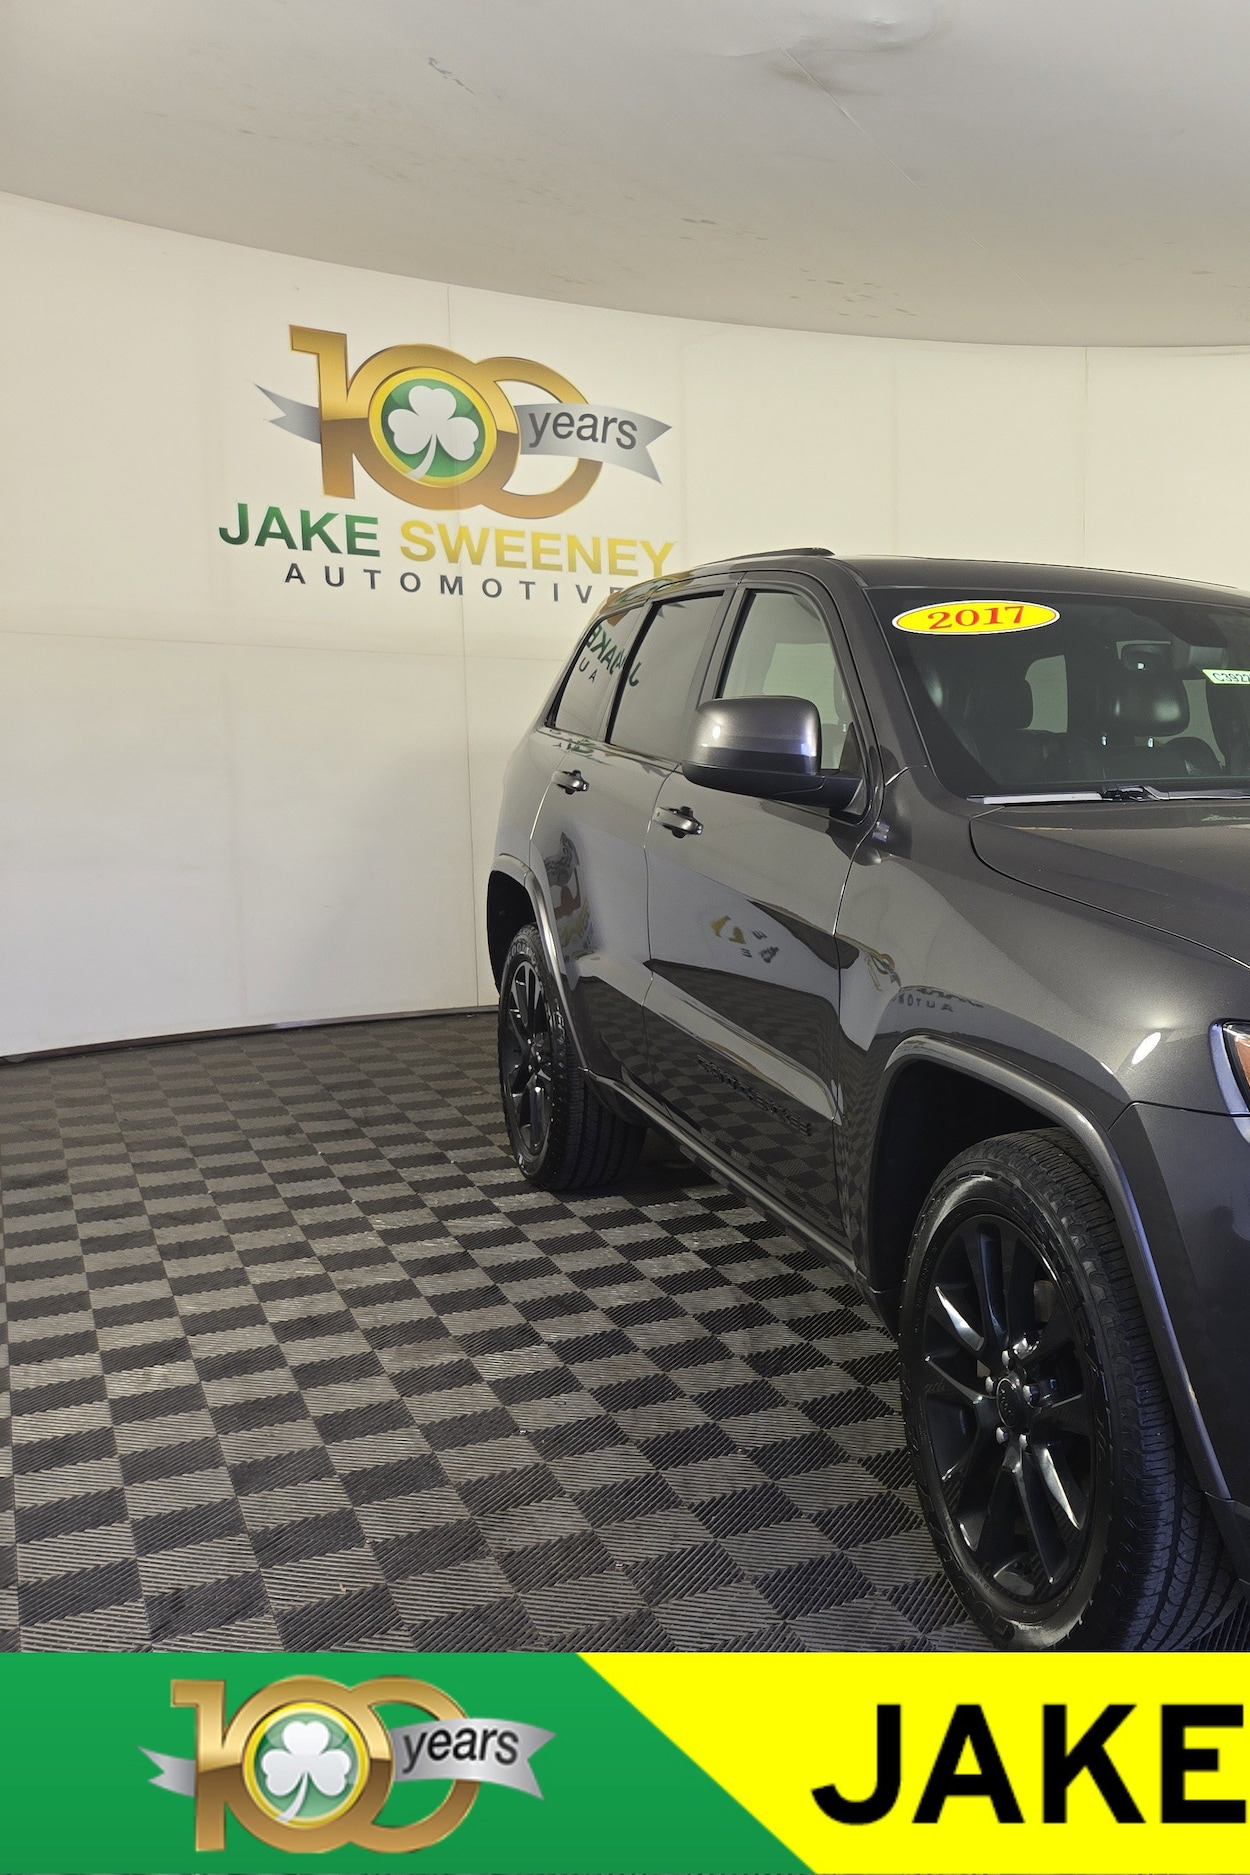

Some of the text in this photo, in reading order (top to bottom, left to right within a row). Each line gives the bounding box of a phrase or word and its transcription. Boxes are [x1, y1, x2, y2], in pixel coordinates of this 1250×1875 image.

[289, 324, 603, 519] 100
[529, 410, 638, 450] years
[218, 502, 675, 578] JAKE SWEENEY
[927, 605, 1026, 630] 2017
